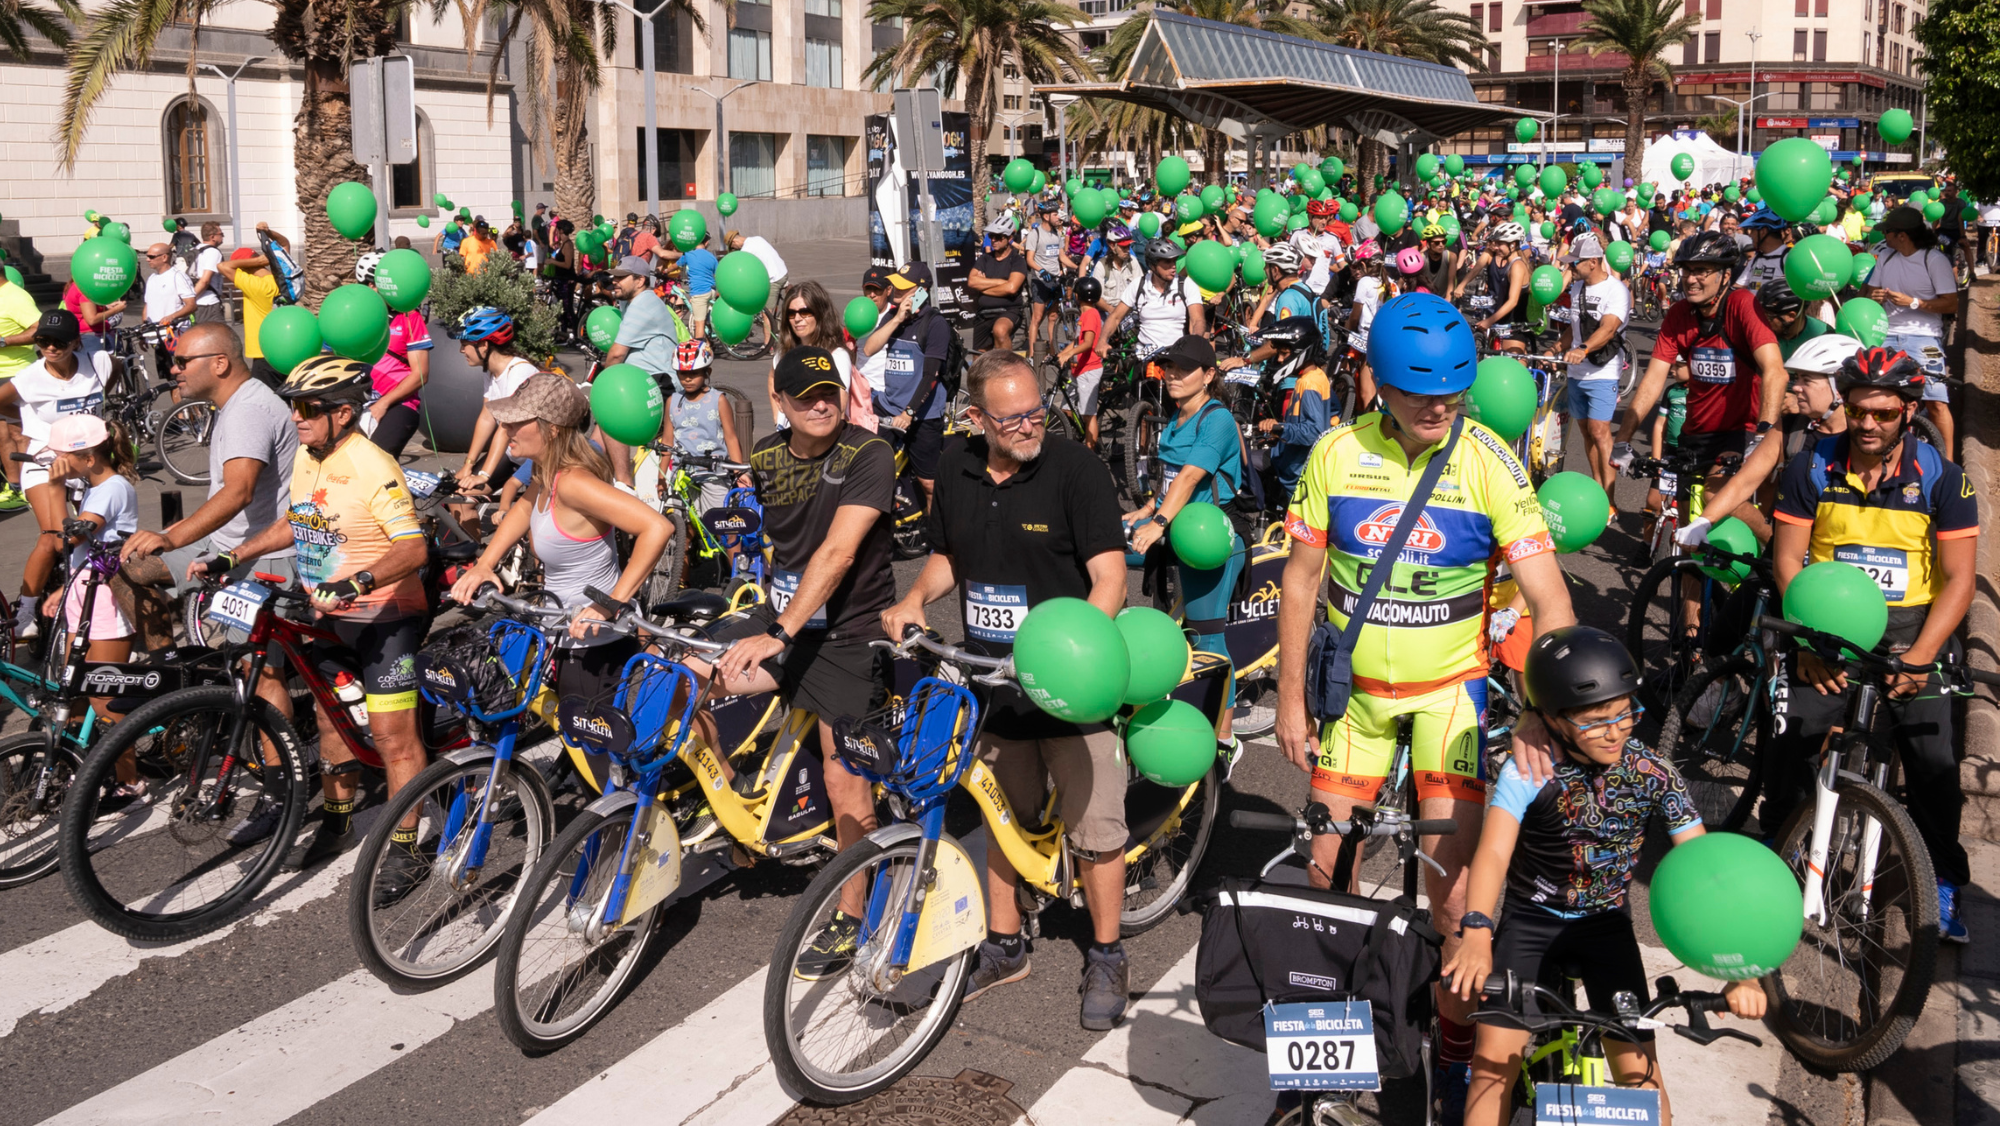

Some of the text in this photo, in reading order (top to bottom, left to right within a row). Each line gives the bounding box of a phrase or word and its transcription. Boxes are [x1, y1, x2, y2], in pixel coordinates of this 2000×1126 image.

[889, 359, 906, 370] 7311
[1697, 362, 1727, 377] 0359
[1472, 426, 1528, 487] NUOVACOMAUTO
[1349, 473, 1390, 481] URSUS
[1365, 524, 1433, 548] NRI
[1511, 542, 1539, 559] NERI
[1837, 551, 1902, 566] FIESTA BICICLETA
[968, 590, 1020, 603] FIESTA BICICLETA
[221, 595, 249, 620] 4031
[973, 605, 1015, 629] 7333
[86, 673, 145, 684] TORROT
[279, 731, 303, 782] MAXXIS
[693, 749, 720, 780] 41143
[980, 776, 1006, 813] 41053
[788, 805, 817, 822] SAGULPA
[1000, 936, 1018, 946] FILA
[1292, 974, 1333, 988] BROMPTON
[1273, 1020, 1305, 1032] FIESTA
[1316, 1019, 1363, 1031] BICICLETA
[1287, 1040, 1355, 1071] 0287
[1545, 1103, 1582, 1118] FIESTA
[1595, 1106, 1649, 1121] BICICLETA
